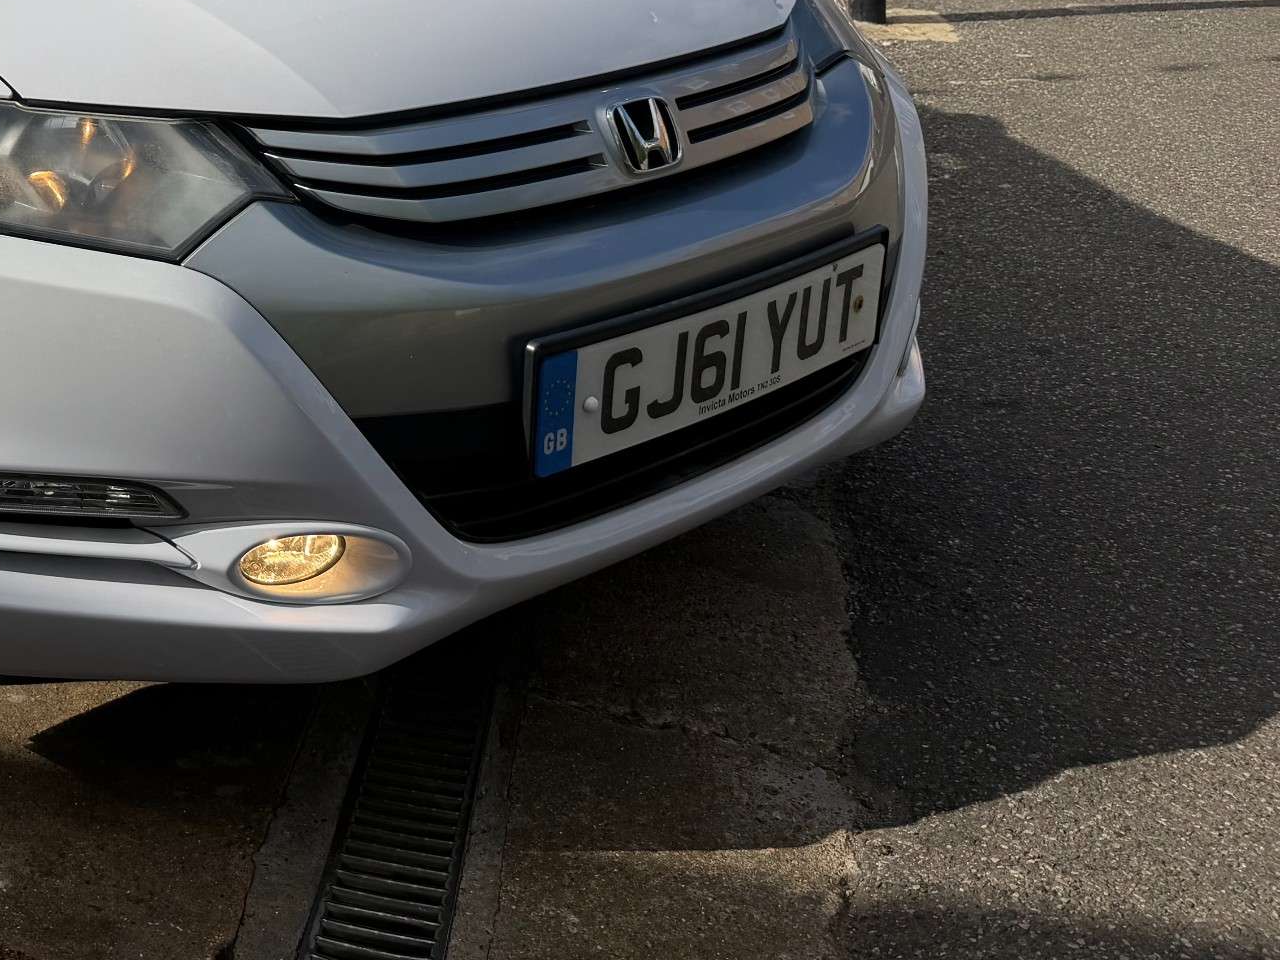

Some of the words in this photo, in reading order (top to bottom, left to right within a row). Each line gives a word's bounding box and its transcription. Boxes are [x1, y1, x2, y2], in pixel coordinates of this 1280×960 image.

[600, 310, 748, 435] GJ61
[767, 263, 865, 374] YUT
[698, 398, 726, 416] Invicta
[728, 386, 755, 403] Motors
[543, 427, 568, 455] GB
